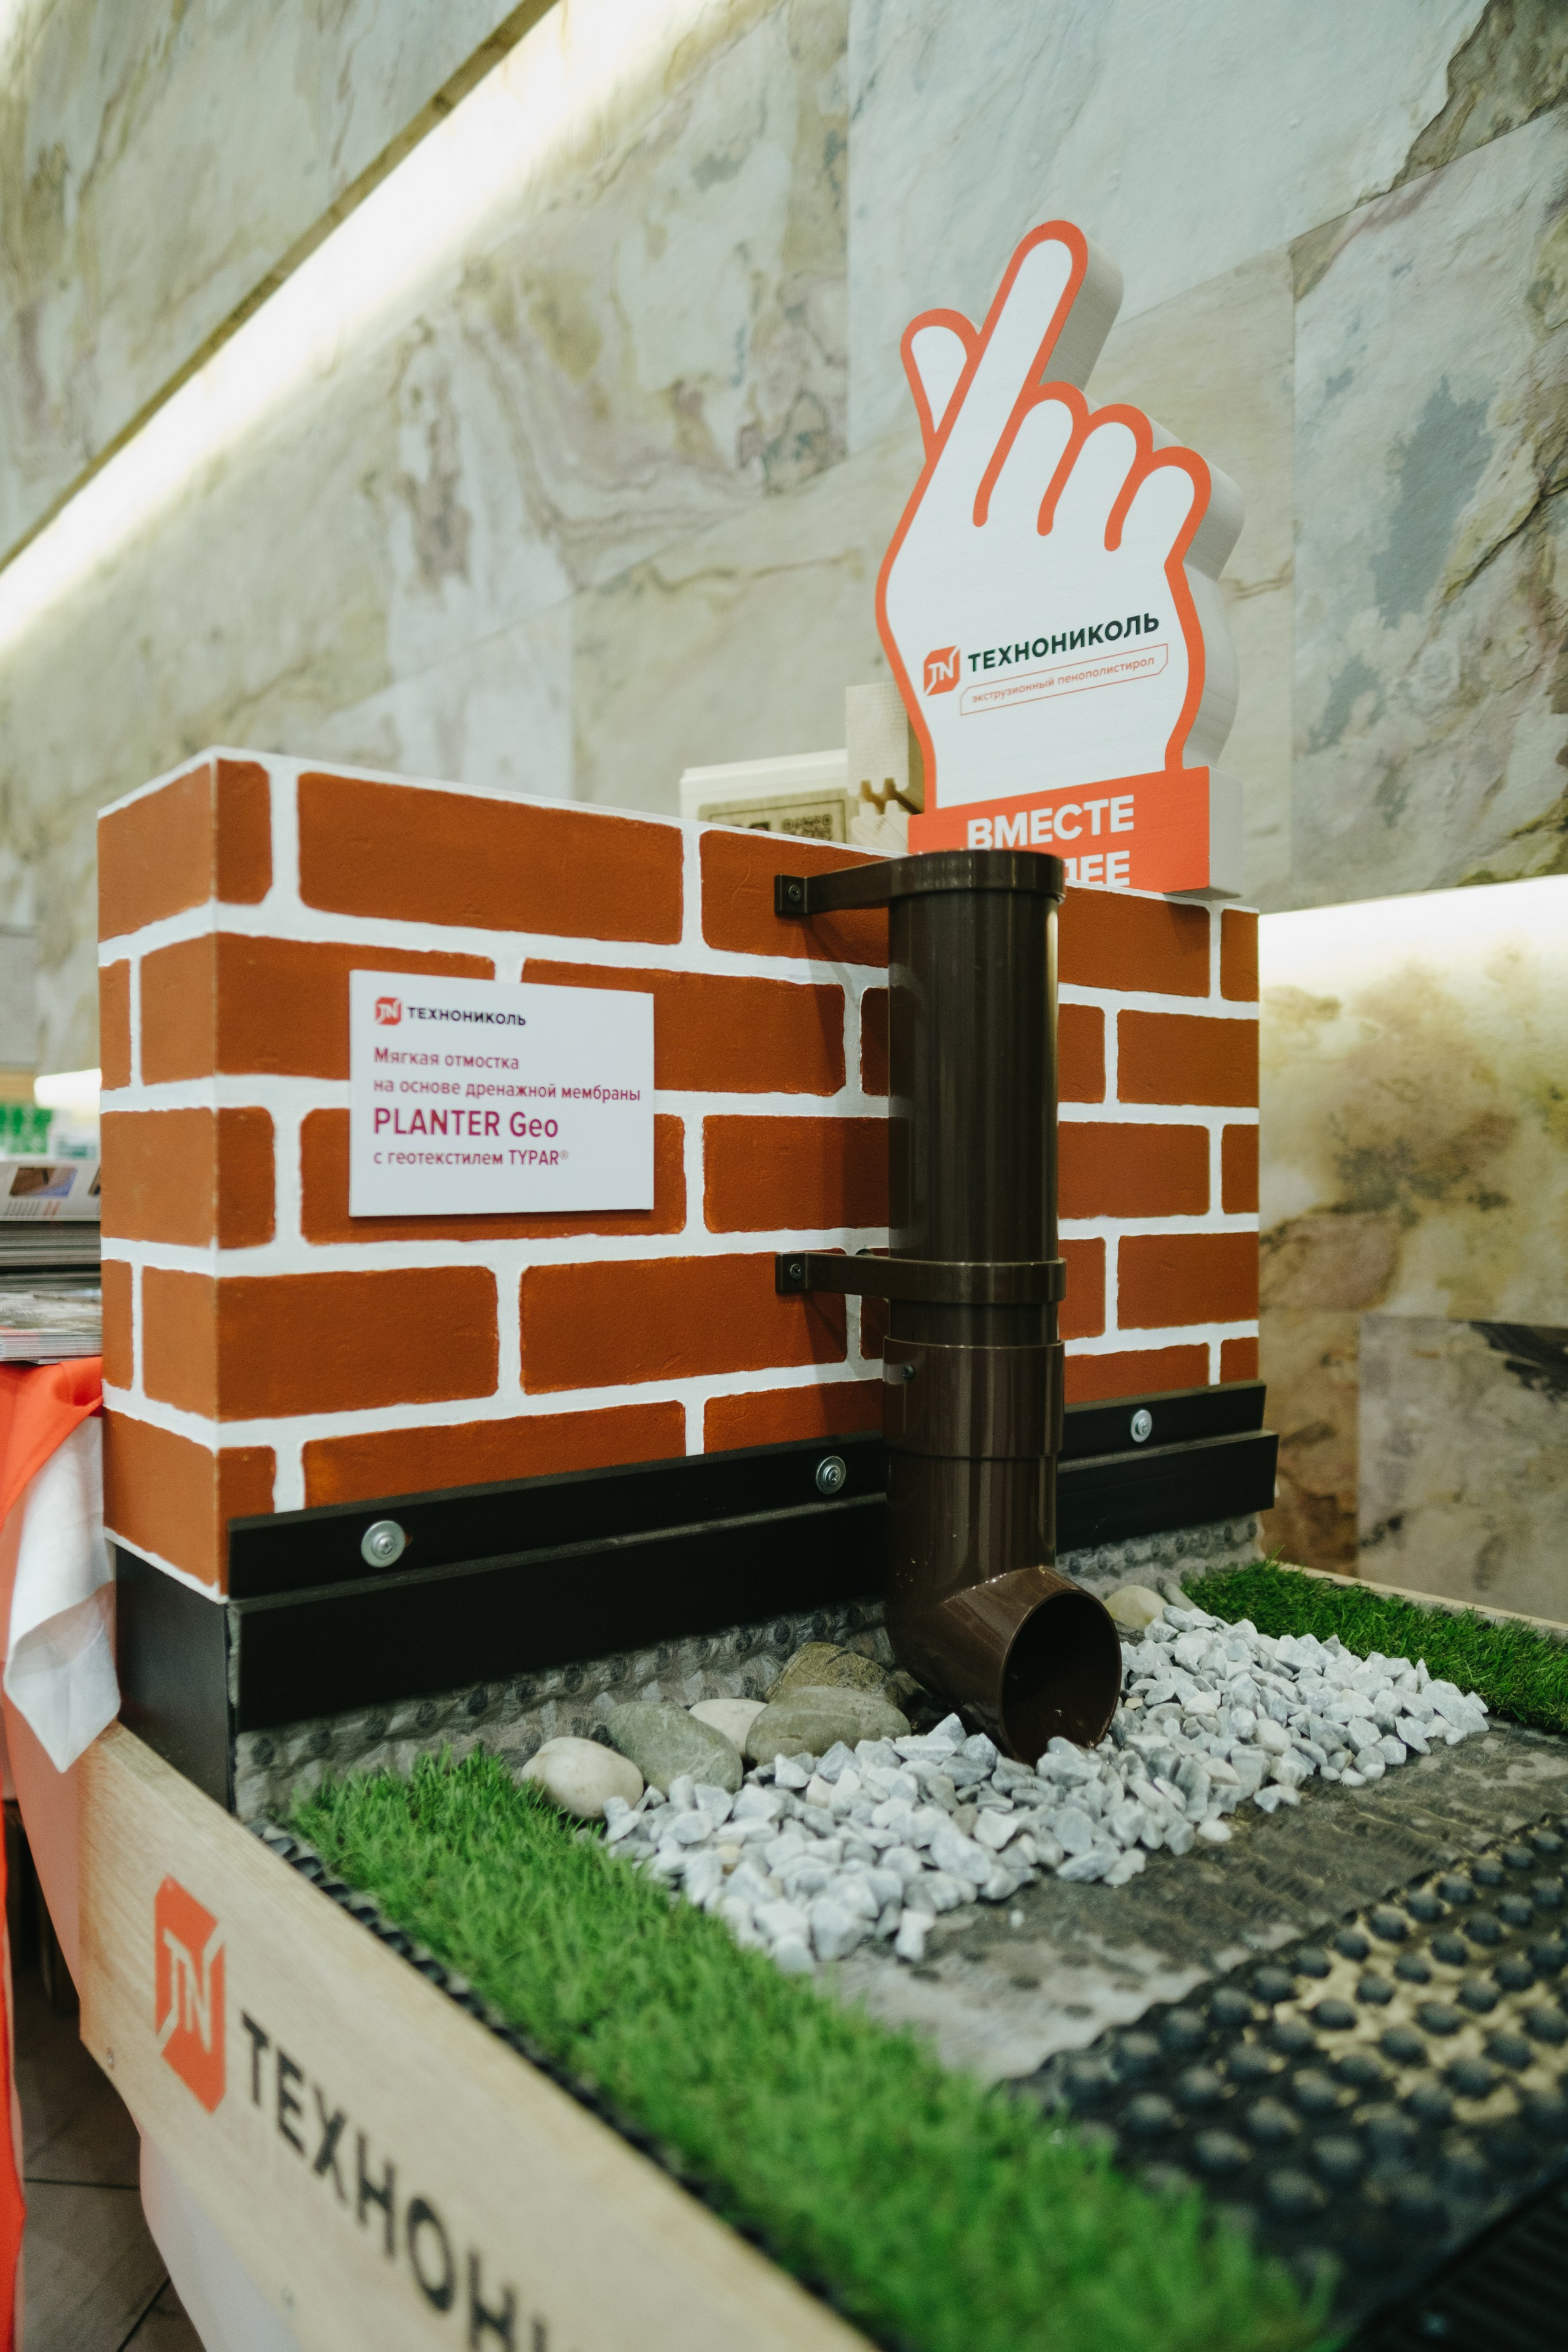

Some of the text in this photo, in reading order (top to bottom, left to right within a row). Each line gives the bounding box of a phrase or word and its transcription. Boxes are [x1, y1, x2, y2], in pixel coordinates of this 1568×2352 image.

[968, 612, 1160, 673] ТЕХНОНИКОЛЬ
[971, 657, 1155, 704] экструзионный пенополистирол
[967, 794, 1134, 850] ВМЕСТЕ
[407, 1006, 527, 1027] ТЕХНОНИКОЛЬ
[374, 1047, 520, 1070] Мягкая отмостка
[374, 1079, 641, 1104] на основе дренажной мембраны
[374, 1107, 559, 1139] PLANTER Geo
[373, 1152, 383, 1165] с
[388, 1152, 503, 1166] геотекстилем
[239, 2008, 549, 2352] ТЕХНОН
